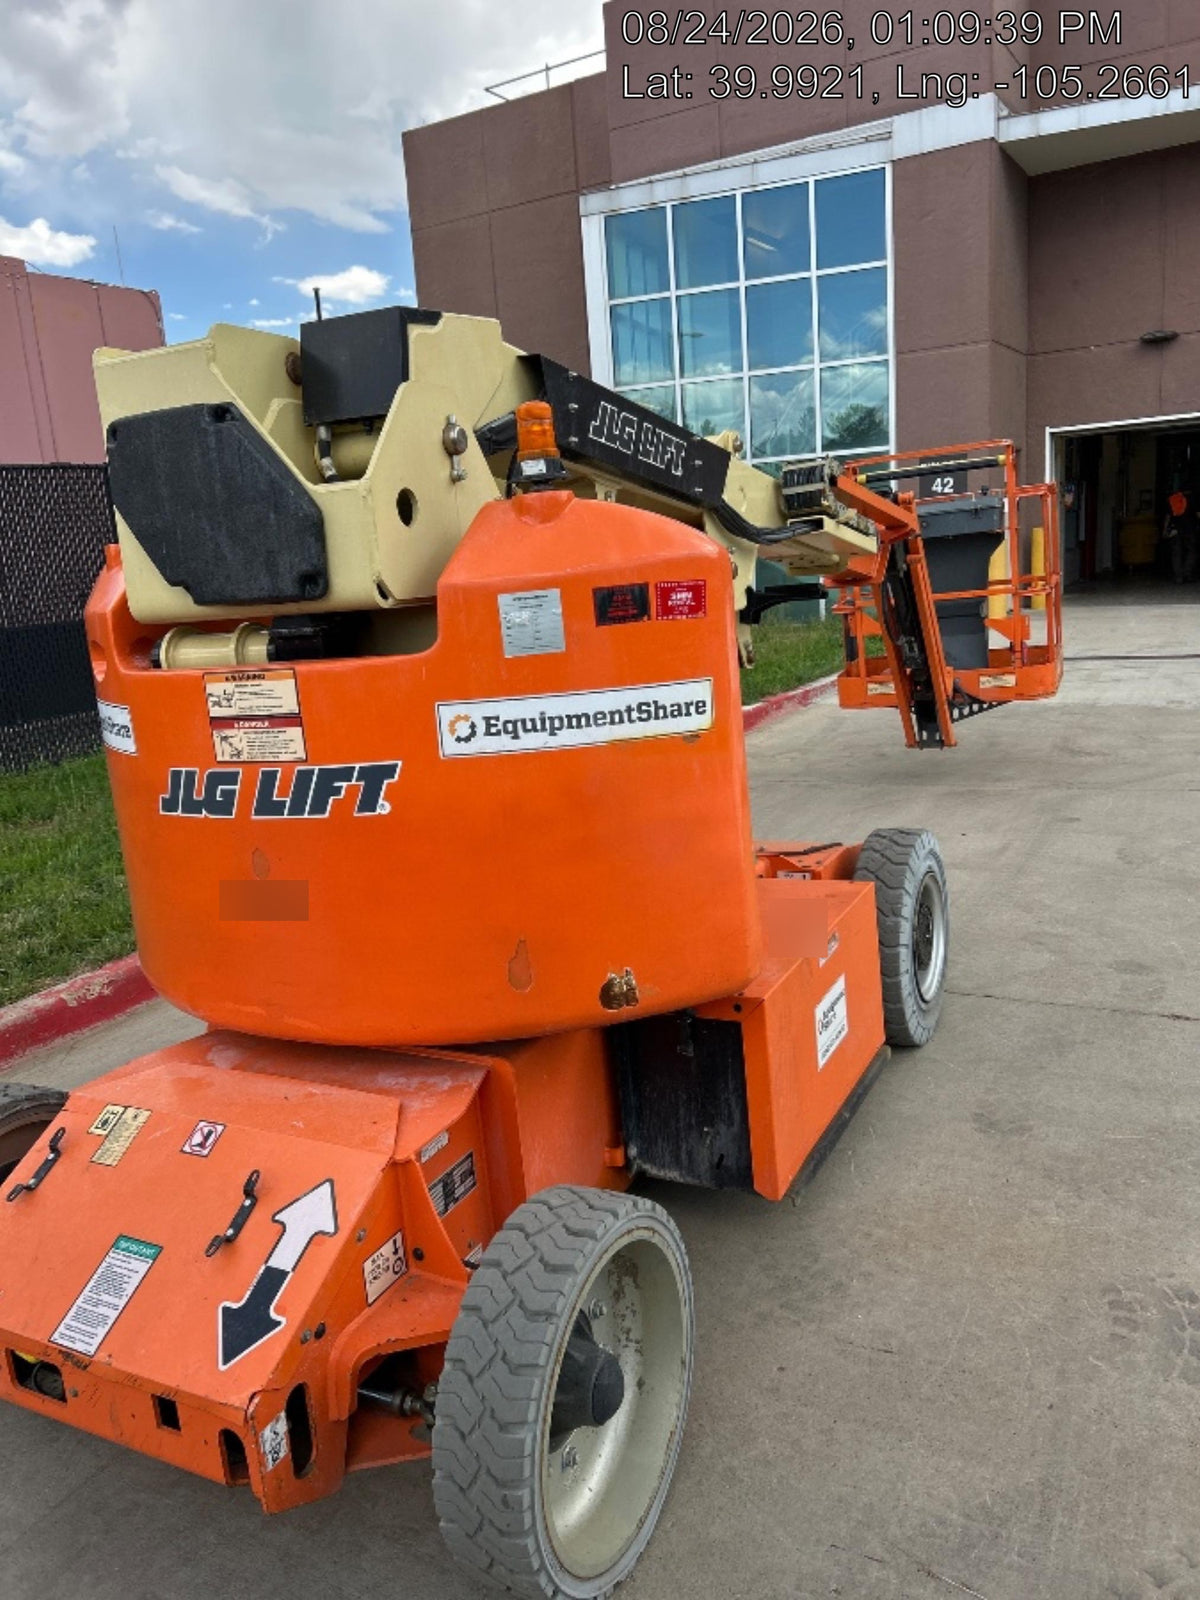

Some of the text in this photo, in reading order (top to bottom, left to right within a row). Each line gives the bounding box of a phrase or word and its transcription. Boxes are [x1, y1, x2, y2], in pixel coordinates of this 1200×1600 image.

[589, 401, 687, 477] JLG LIFT
[931, 477, 954, 493] 42
[482, 699, 707, 740] EquipmentShare
[159, 767, 242, 818] JLG
